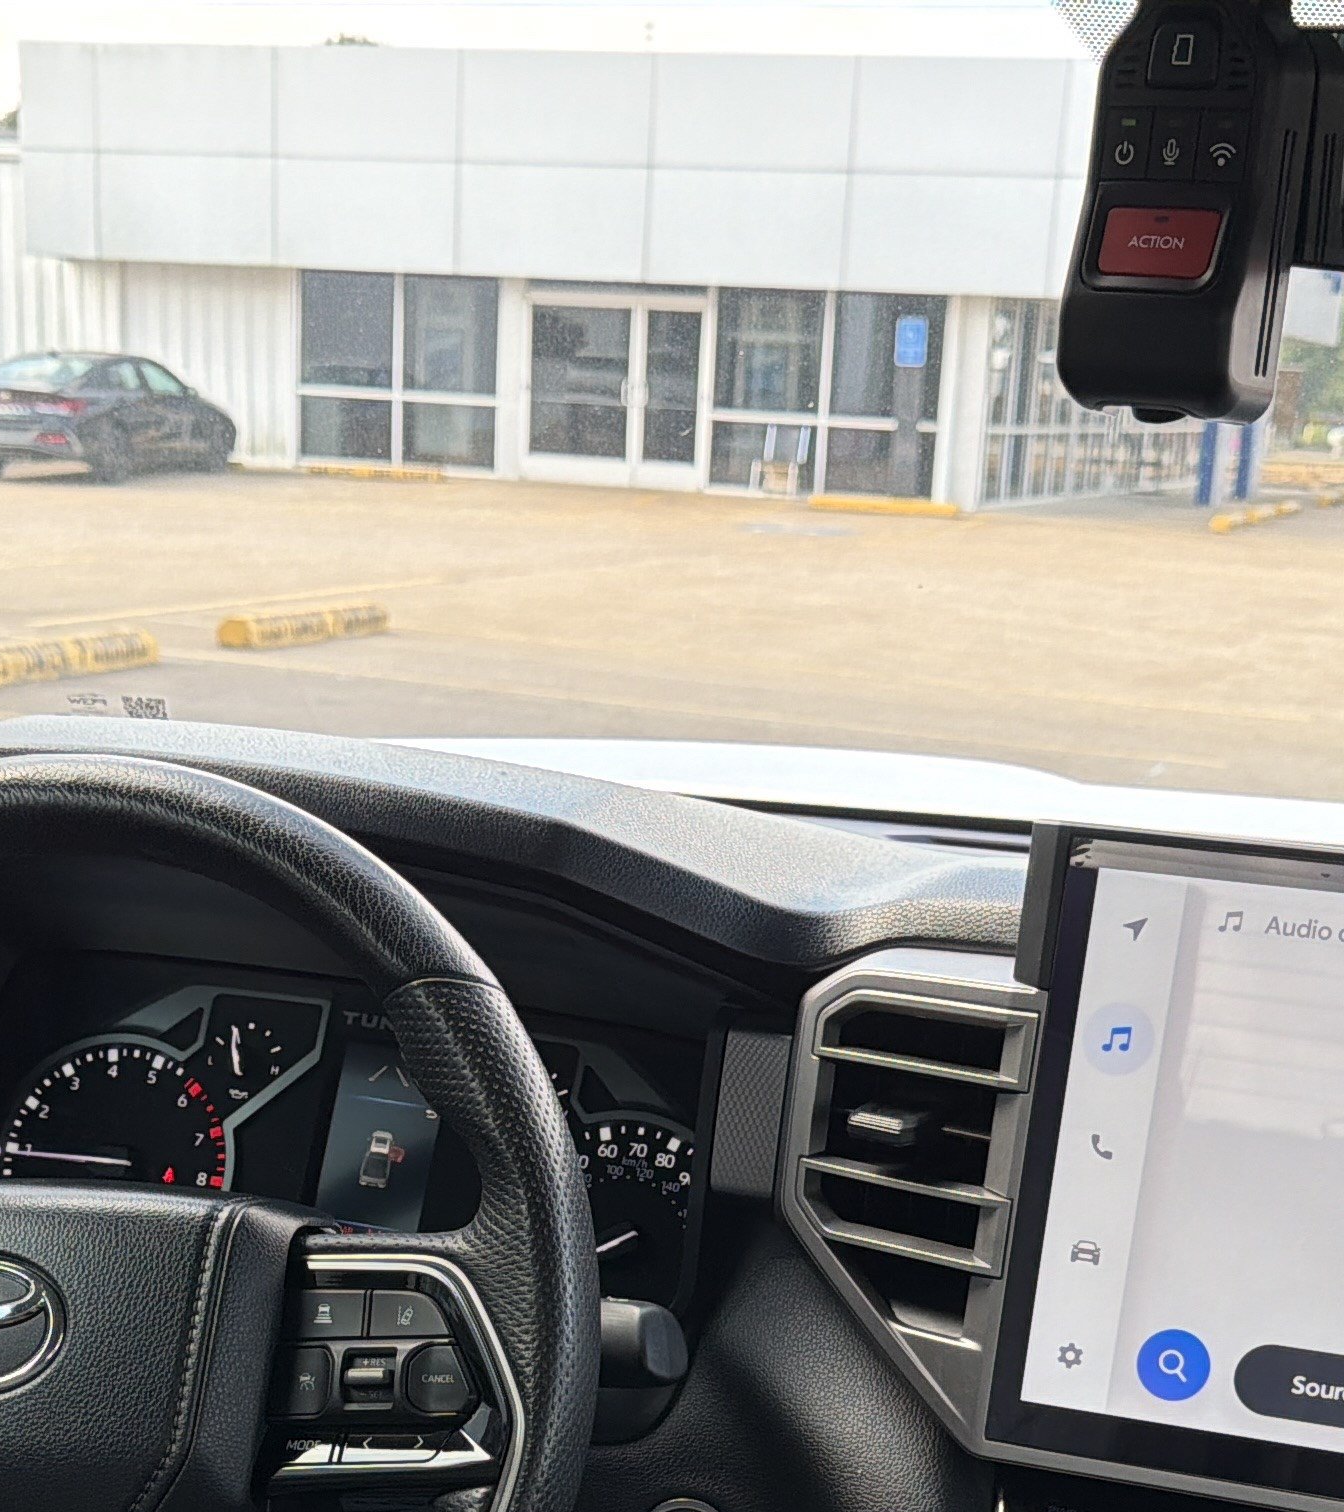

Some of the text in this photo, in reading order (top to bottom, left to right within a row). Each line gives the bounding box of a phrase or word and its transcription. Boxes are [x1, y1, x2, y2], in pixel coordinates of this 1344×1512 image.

[1127, 234, 1186, 250] ACTION
[1264, 915, 1334, 942] Audio
[107, 1064, 118, 1079] 4
[146, 1070, 157, 1085] 5
[269, 1065, 280, 1075] H
[69, 1076, 81, 1091] 3
[176, 1094, 188, 1108] 6
[38, 1104, 51, 1120] 2
[194, 1132, 205, 1147] 7
[597, 1143, 618, 1159] 60
[628, 1142, 648, 1158] 70
[621, 1156, 648, 1169] km/h
[654, 1152, 676, 1169] 80
[606, 1164, 625, 1177] 100
[636, 1167, 654, 1180] 120
[195, 1171, 208, 1187] 8
[661, 1180, 681, 1193] 140
[421, 1373, 455, 1384] CANCEL
[286, 1439, 322, 1451] MODE
